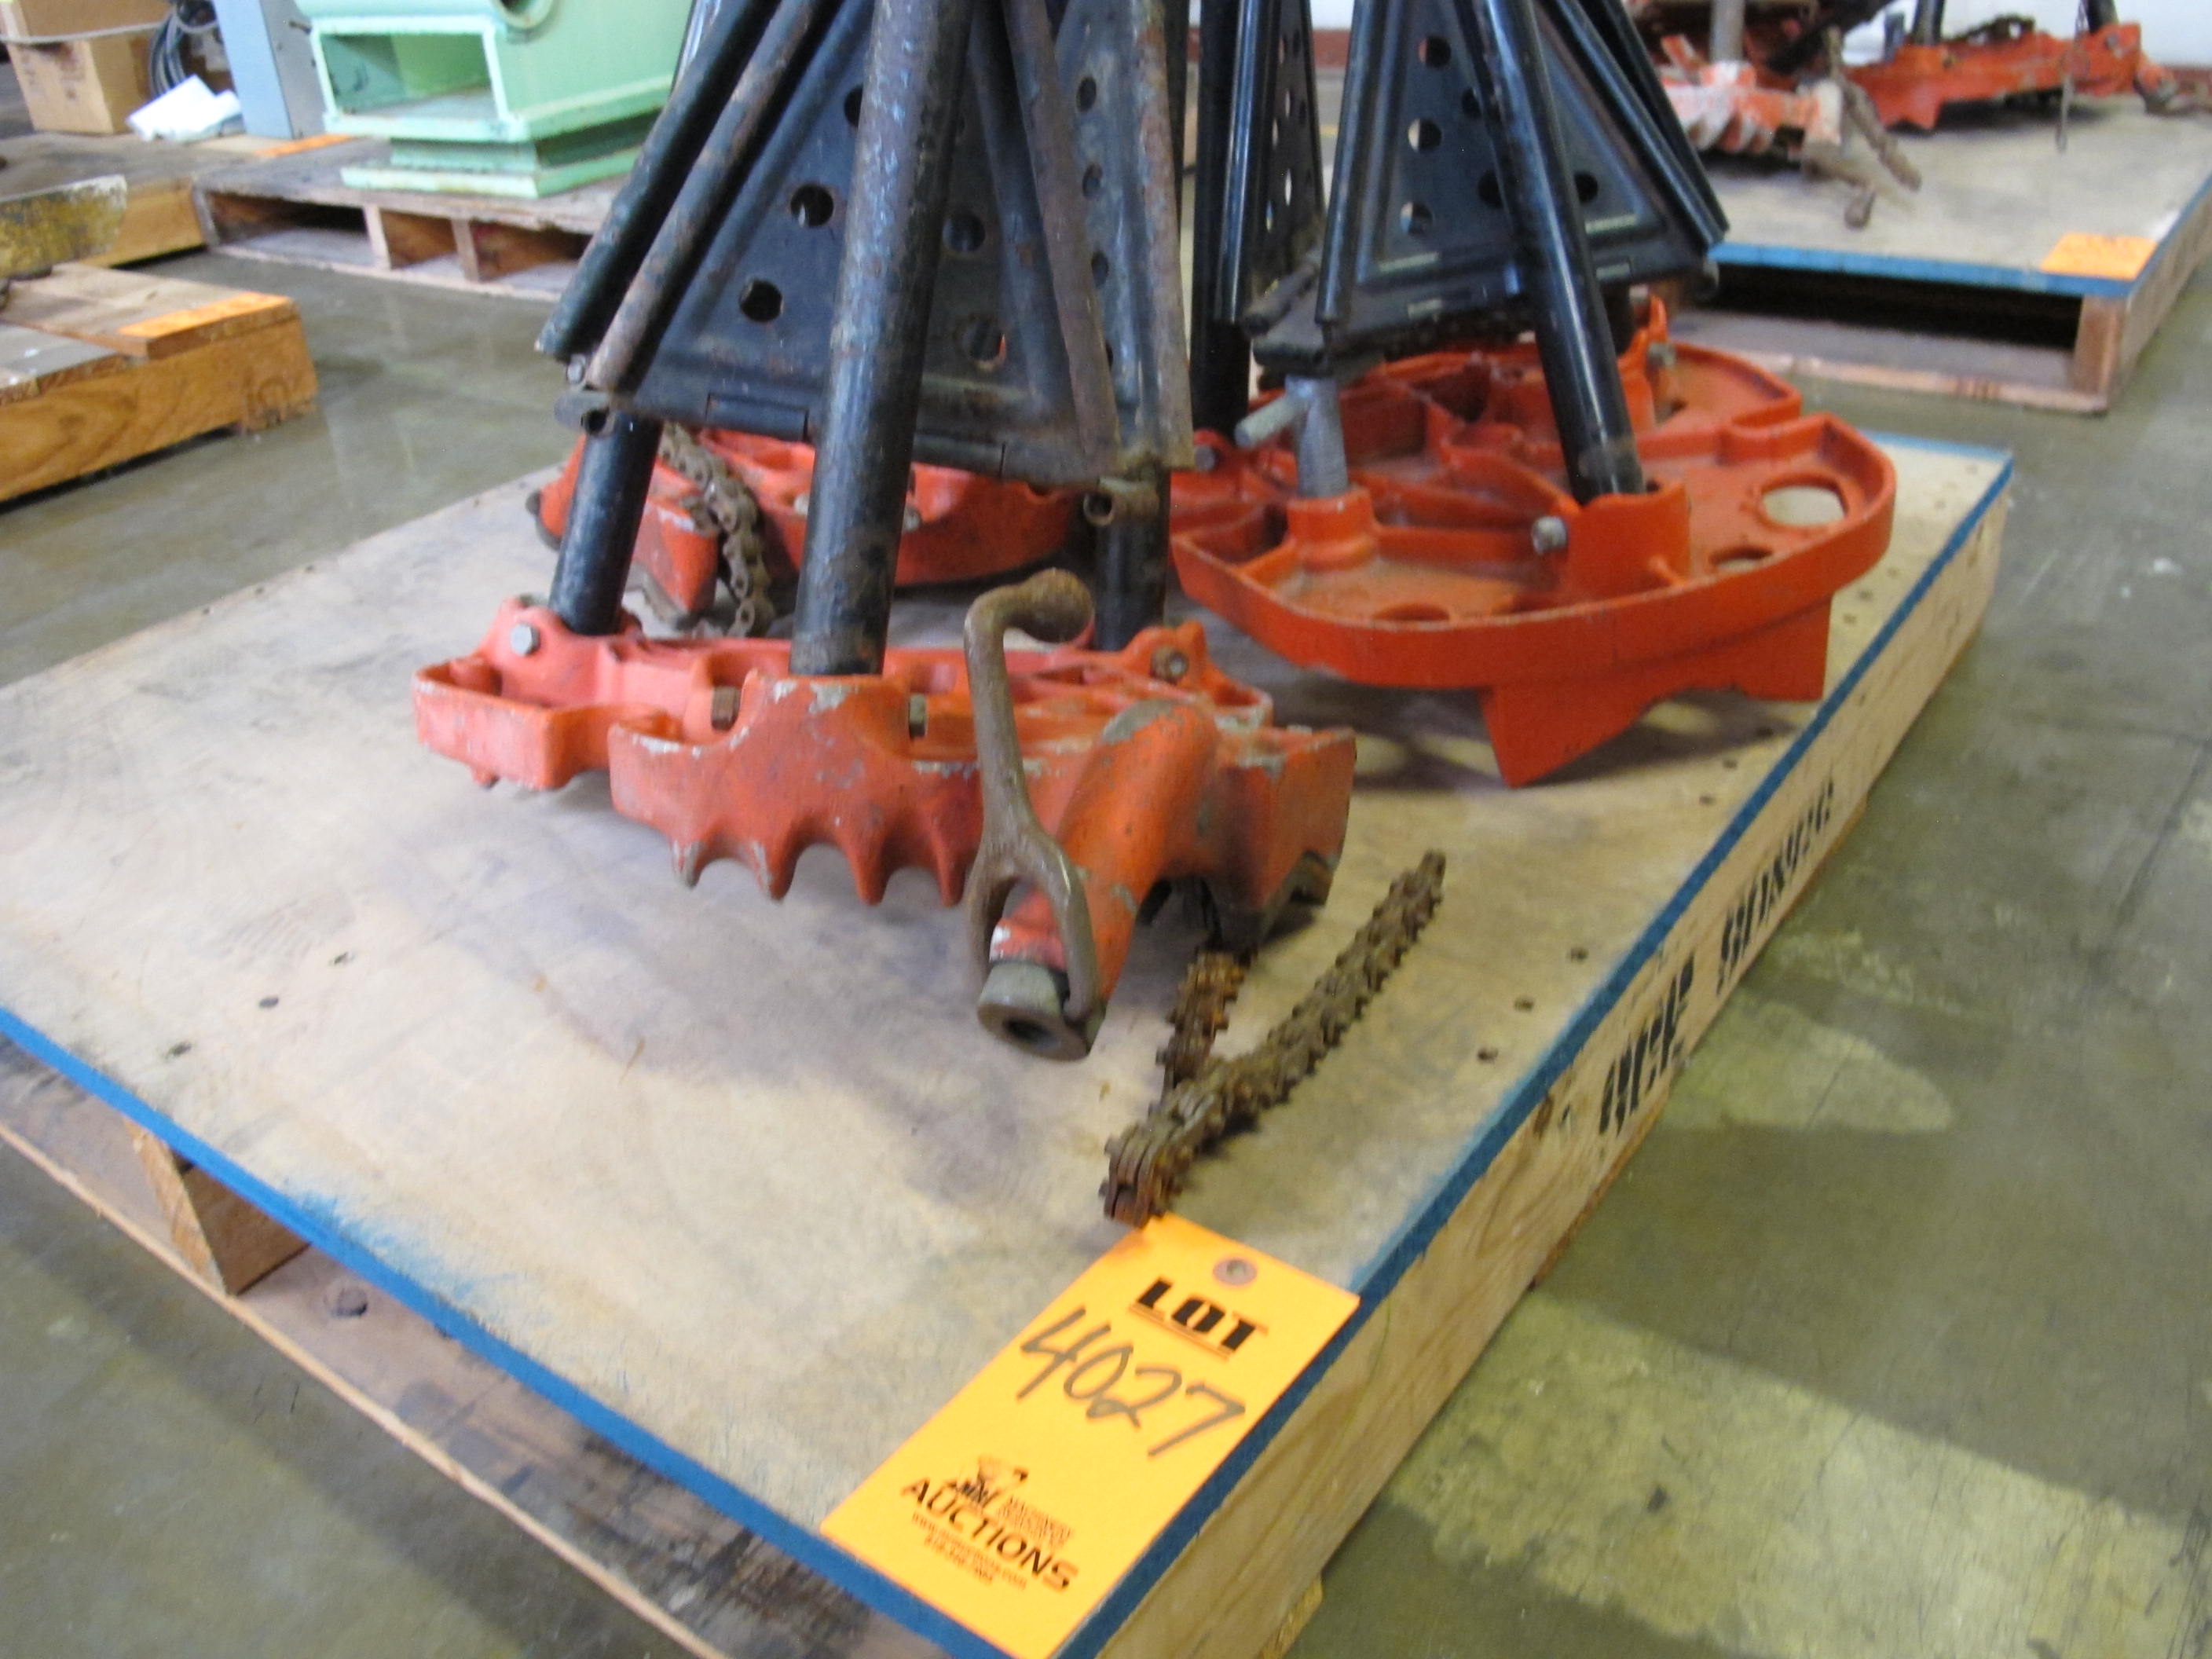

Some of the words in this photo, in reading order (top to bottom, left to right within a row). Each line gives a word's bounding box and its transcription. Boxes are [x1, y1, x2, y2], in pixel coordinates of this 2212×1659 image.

[1135, 1275, 1269, 1354] LOT
[1016, 1306, 1246, 1457] 4027
[900, 1477, 1079, 1592] AUCTIONS
